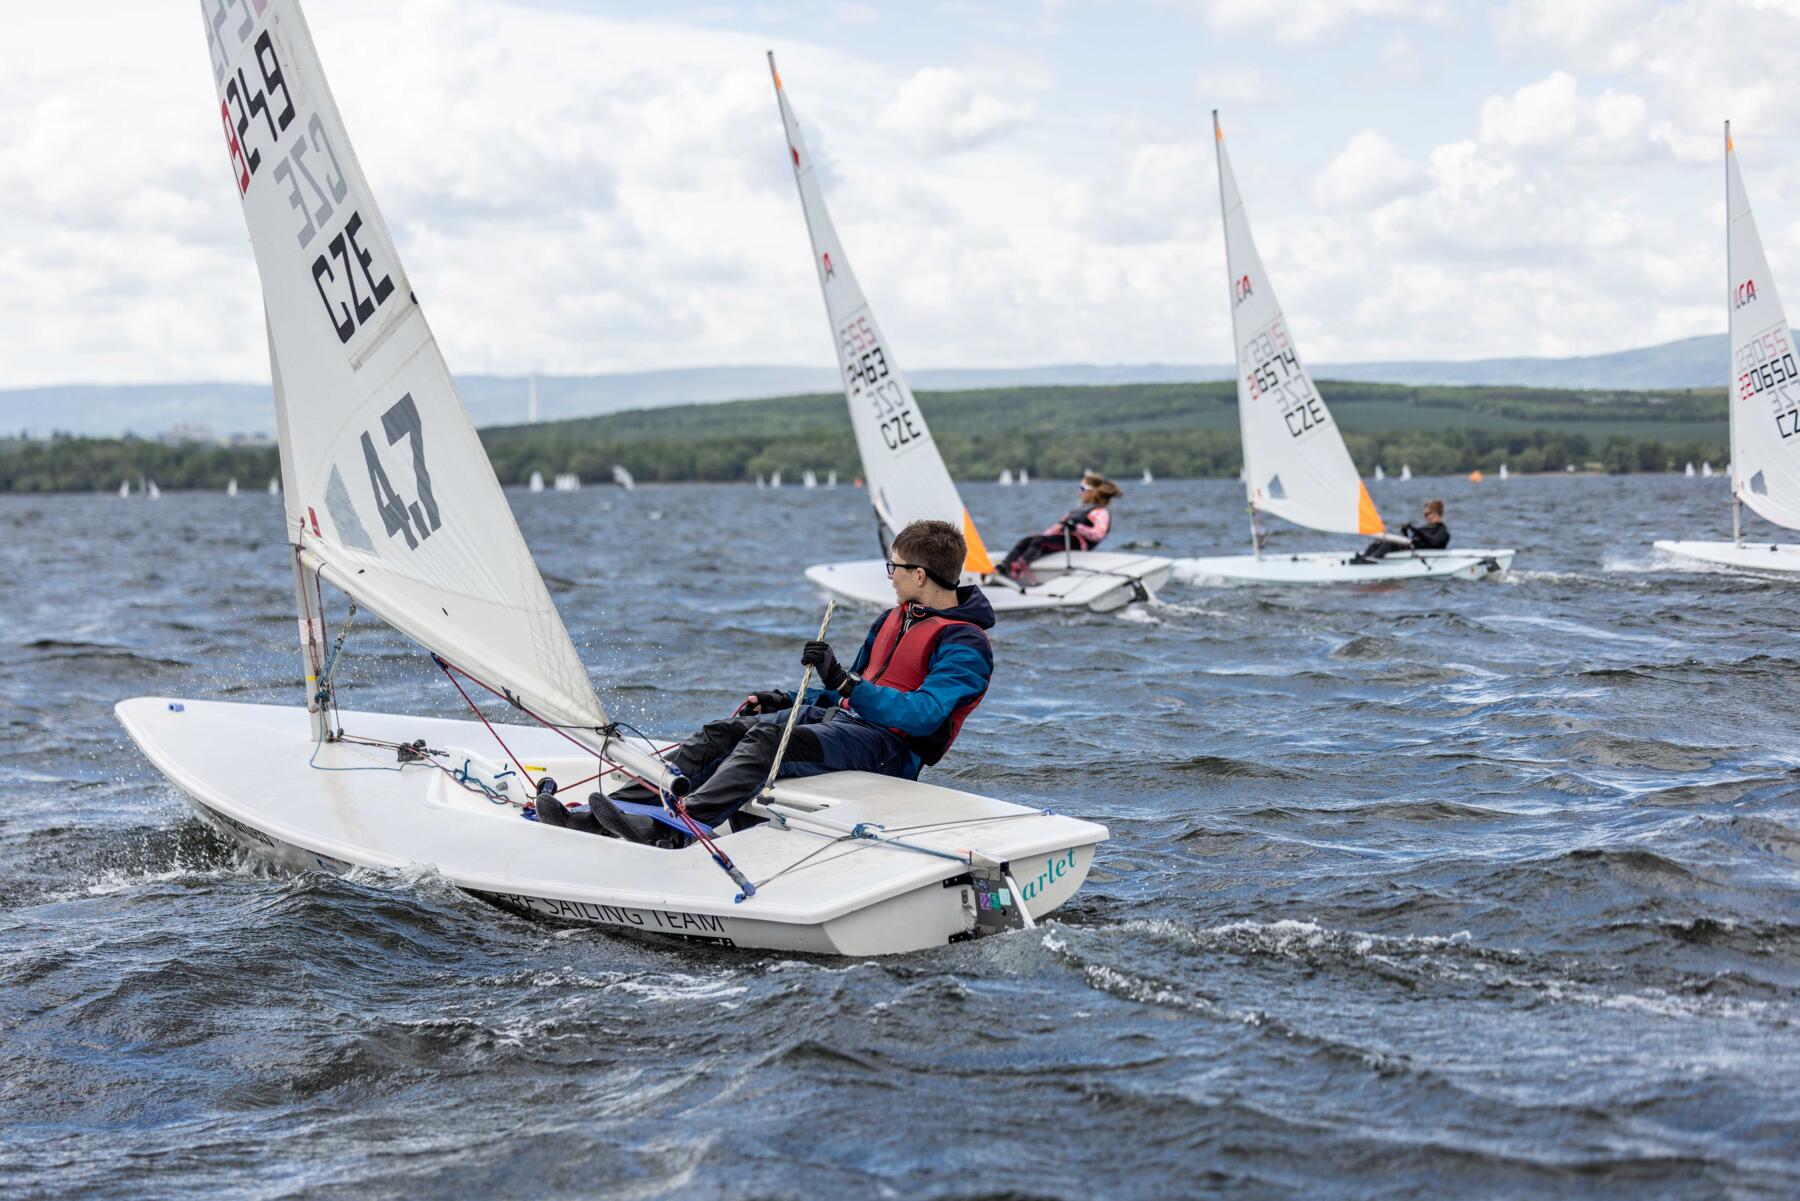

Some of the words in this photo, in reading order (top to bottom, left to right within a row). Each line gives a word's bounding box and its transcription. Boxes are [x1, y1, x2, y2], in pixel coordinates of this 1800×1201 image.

[312, 211, 395, 343] CZE
[880, 410, 921, 451] CZE
[1285, 398, 1325, 438] CZE
[542, 897, 645, 925] SAILING
